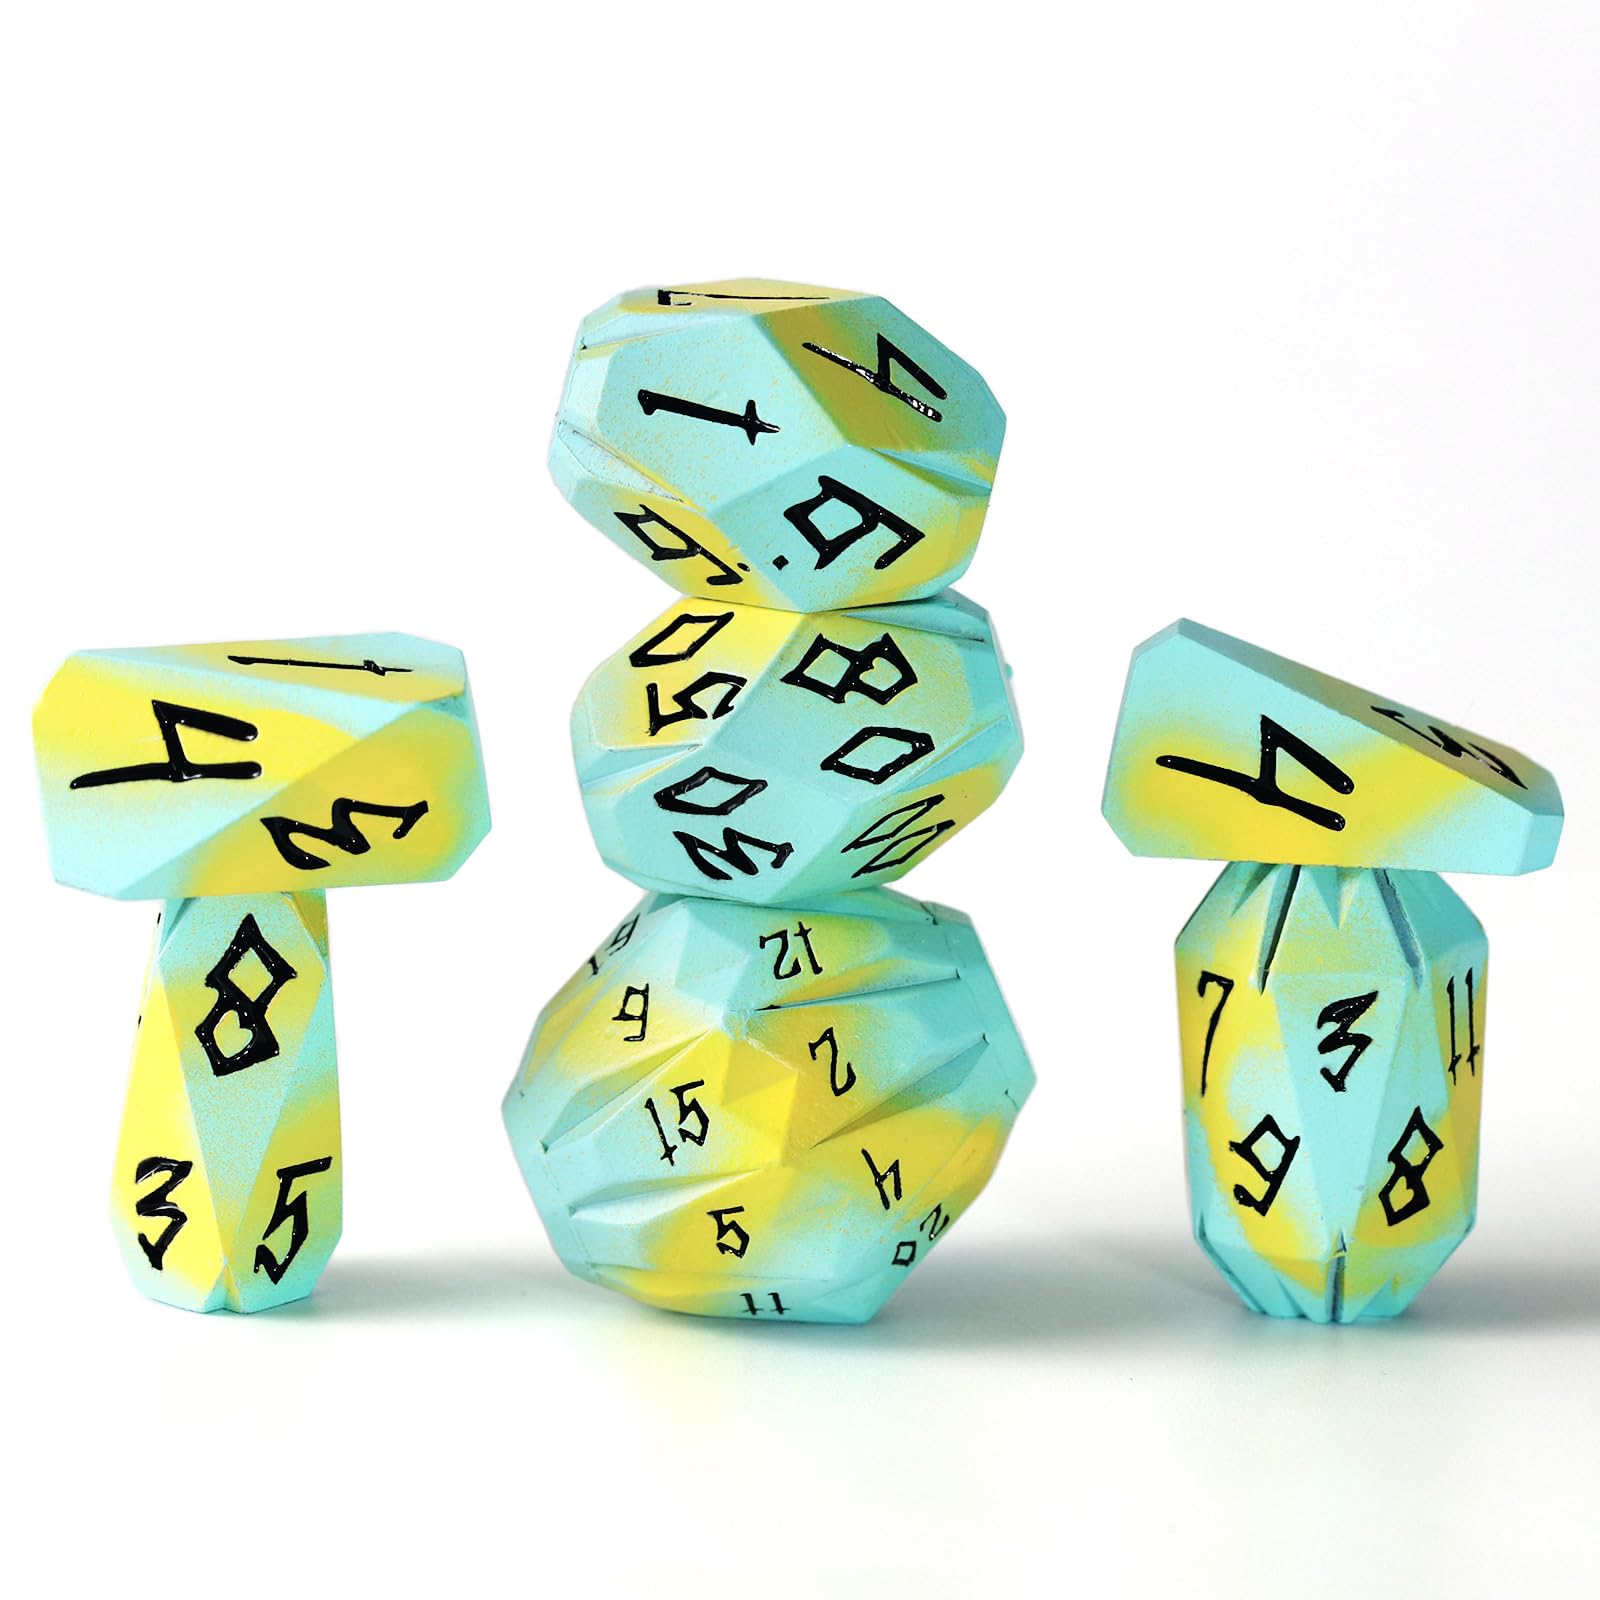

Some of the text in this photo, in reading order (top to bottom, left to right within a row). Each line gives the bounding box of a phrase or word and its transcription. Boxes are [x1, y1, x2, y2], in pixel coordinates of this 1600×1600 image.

[637, 388, 780, 446] 1
[801, 332, 948, 423] 4
[227, 655, 413, 677] 1
[69, 699, 262, 790] 4
[1155, 714, 1355, 832] 4
[259, 797, 429, 871] 3
[194, 913, 298, 1077] 8
[759, 921, 823, 980] 12
[808, 1026, 857, 1097] 2
[1197, 970, 1235, 1097] 7
[1316, 990, 1379, 1093] 3
[1446, 967, 1481, 1086] 11
[644, 1079, 710, 1167] 15
[1378, 1105, 1445, 1227] 8
[135, 1156, 193, 1271] 3
[253, 1156, 333, 1285] 5
[861, 1148, 903, 1211] 4
[706, 1205, 750, 1259] 5
